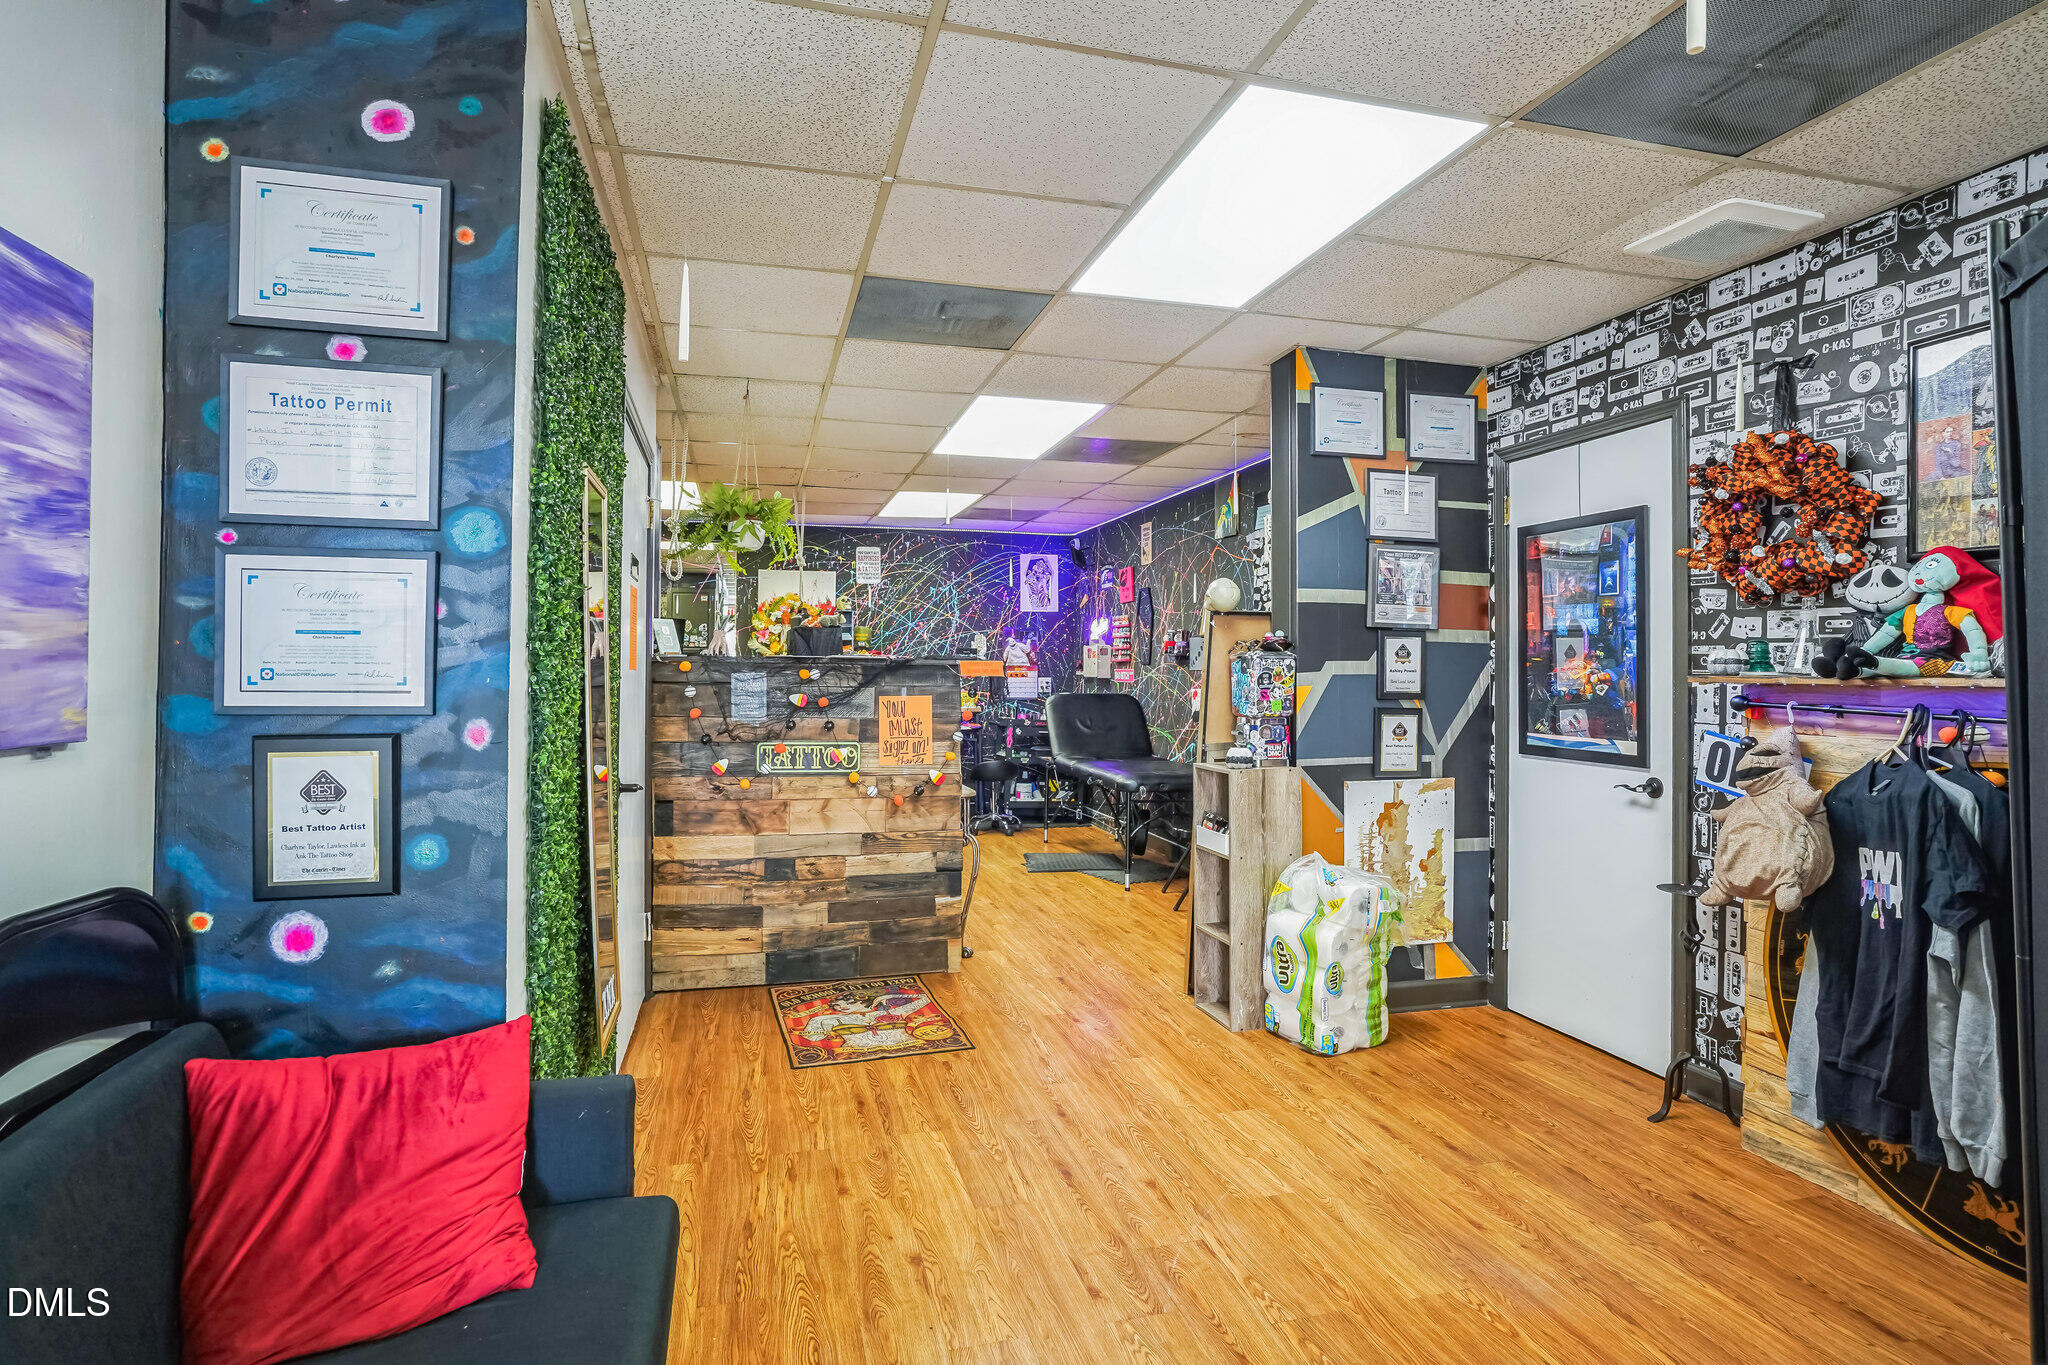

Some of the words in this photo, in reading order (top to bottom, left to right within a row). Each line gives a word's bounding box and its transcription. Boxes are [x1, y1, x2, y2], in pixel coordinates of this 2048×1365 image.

[307, 200, 378, 224] Certificate
[269, 393, 327, 409] Tattoo
[335, 396, 392, 413] Permit
[1383, 488, 1402, 496] Tattoo
[293, 583, 364, 604] Certificate
[310, 784, 335, 796] BEST
[306, 824, 337, 832] Tattoo
[339, 823, 366, 831] Artist
[1276, 940, 1290, 985] Ultra
[801, 989, 839, 1003] SCHOOL
[842, 981, 884, 991] TATTOO
[888, 977, 914, 986] EXPO
